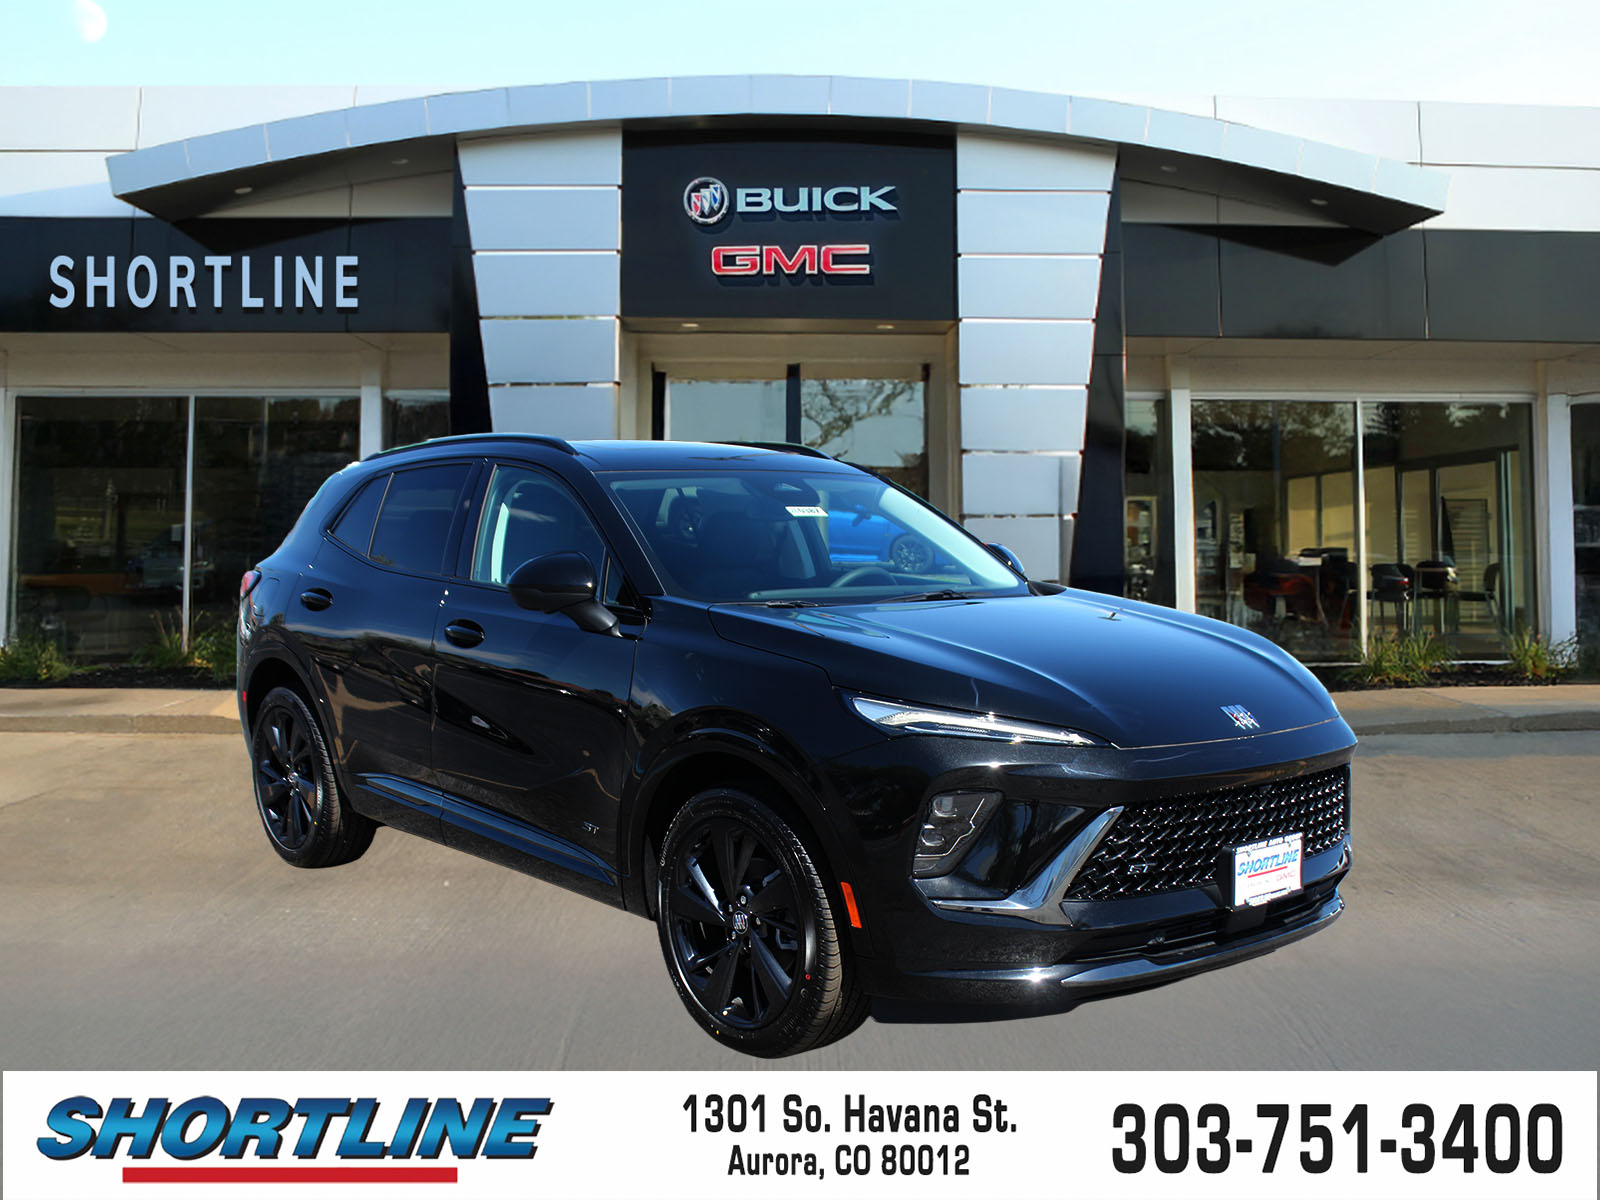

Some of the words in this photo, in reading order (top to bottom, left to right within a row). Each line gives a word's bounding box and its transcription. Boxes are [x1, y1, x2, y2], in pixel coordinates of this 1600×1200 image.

[736, 185, 898, 212] BUICK
[711, 243, 870, 275] GMC
[49, 255, 359, 309] SHORTLINE
[582, 821, 600, 835] ST
[1237, 849, 1299, 876] SHORTLINE
